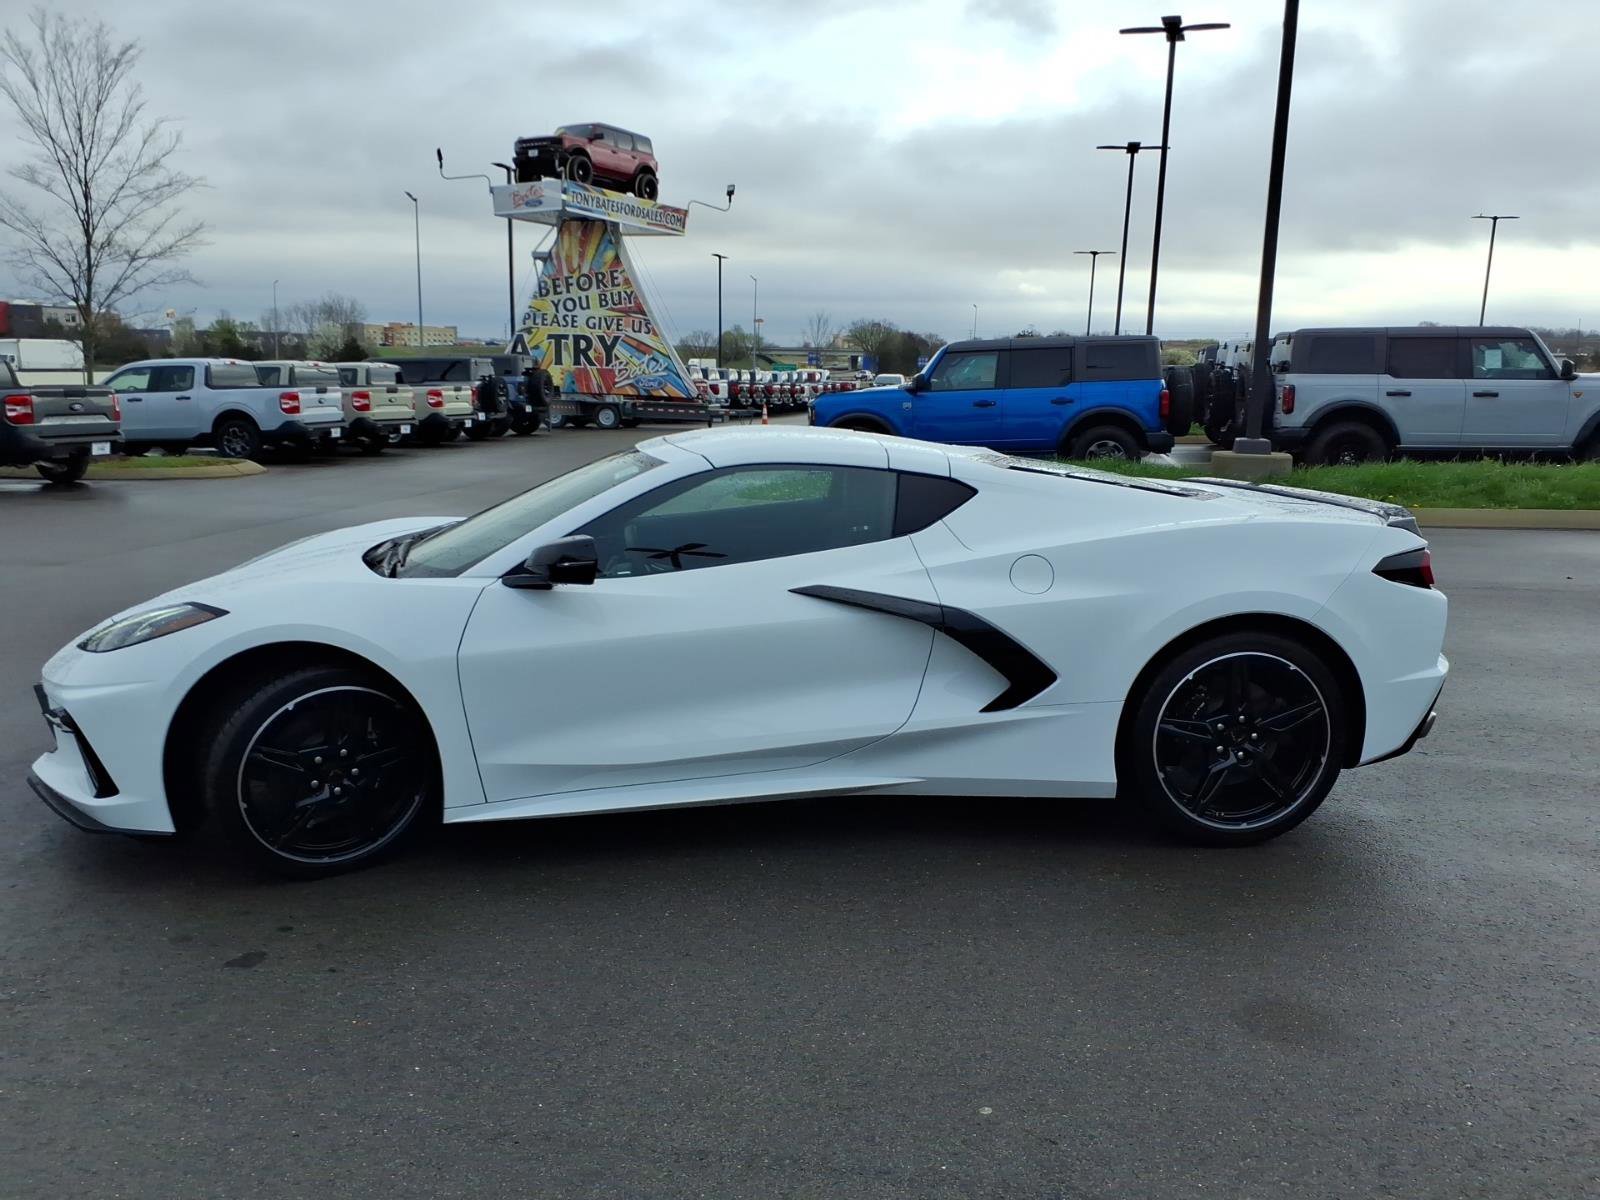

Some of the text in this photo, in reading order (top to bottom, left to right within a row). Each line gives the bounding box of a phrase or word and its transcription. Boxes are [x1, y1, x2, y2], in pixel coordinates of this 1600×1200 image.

[570, 190, 684, 227] TONYBATESFORDSALES.COM
[538, 269, 621, 298] BEFORE
[551, 290, 635, 314] YOU BUY
[522, 312, 652, 335] PLEASE GIVE US
[511, 333, 624, 368] A TRY
